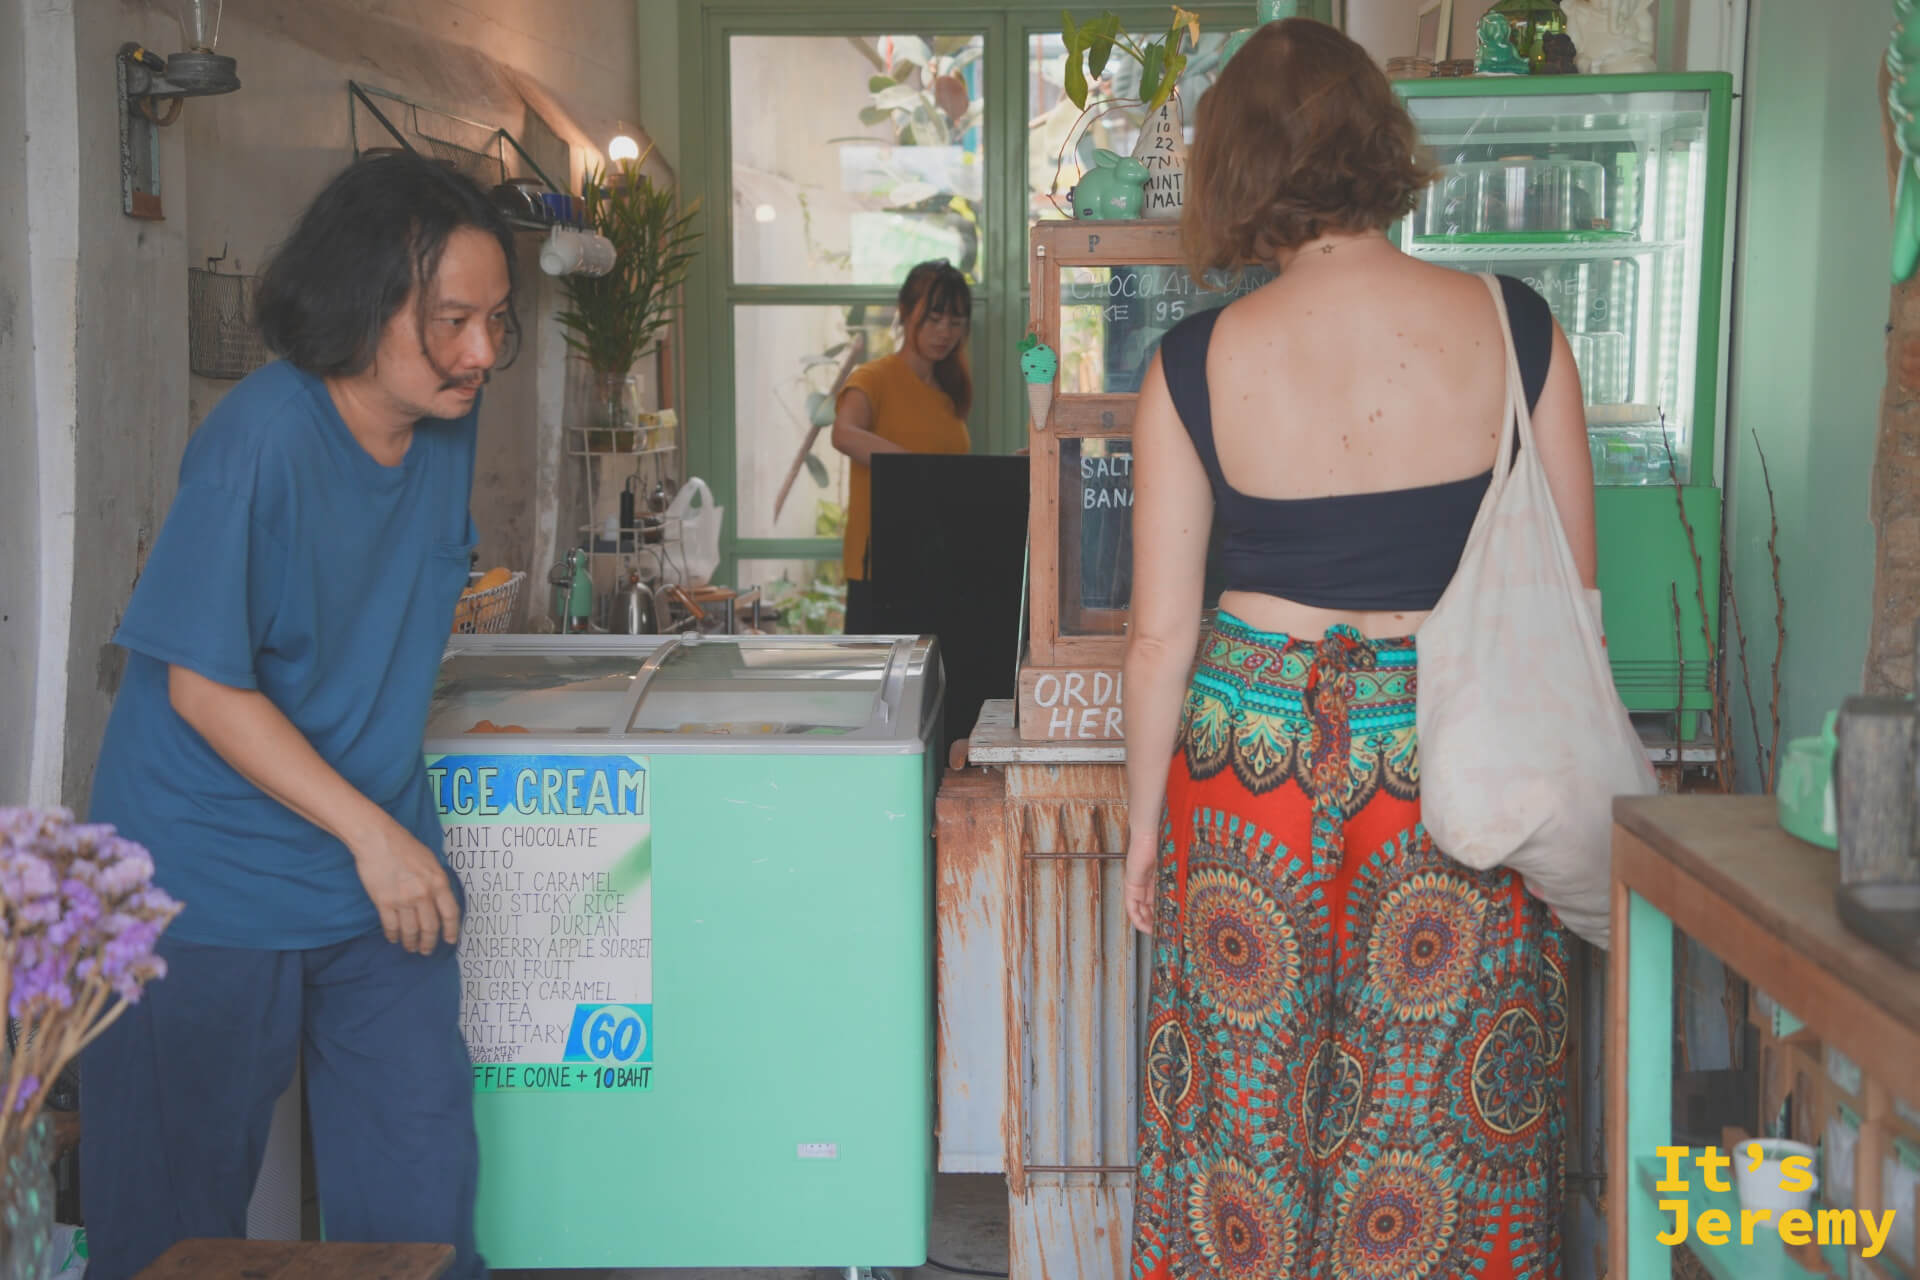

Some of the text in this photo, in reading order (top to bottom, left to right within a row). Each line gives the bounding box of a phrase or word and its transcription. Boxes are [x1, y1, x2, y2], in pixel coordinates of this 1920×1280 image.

[1159, 104, 1168, 120] 4
[1156, 122, 1170, 133] 10
[1155, 136, 1174, 152] 22
[1155, 300, 1185, 321] 95
[1048, 707, 1125, 737] HER
[427, 767, 646, 816] ICE CREAM
[502, 826, 600, 848] CHOCOLATE
[481, 871, 525, 892] SALT
[533, 871, 617, 892] CARAMEL
[510, 893, 576, 914] STICKY
[584, 893, 627, 914] RICE
[550, 914, 620, 936] DURIAN
[547, 937, 595, 958] APPLE
[600, 938, 652, 959] SORBET
[523, 959, 575, 979] FRUIT
[538, 981, 617, 1001] CARAMEL
[496, 1002, 533, 1023] TEA
[589, 1011, 642, 1062] 60
[523, 1066, 571, 1088] CONE
[593, 1066, 615, 1089] 10
[616, 1067, 652, 1088] BAHT
